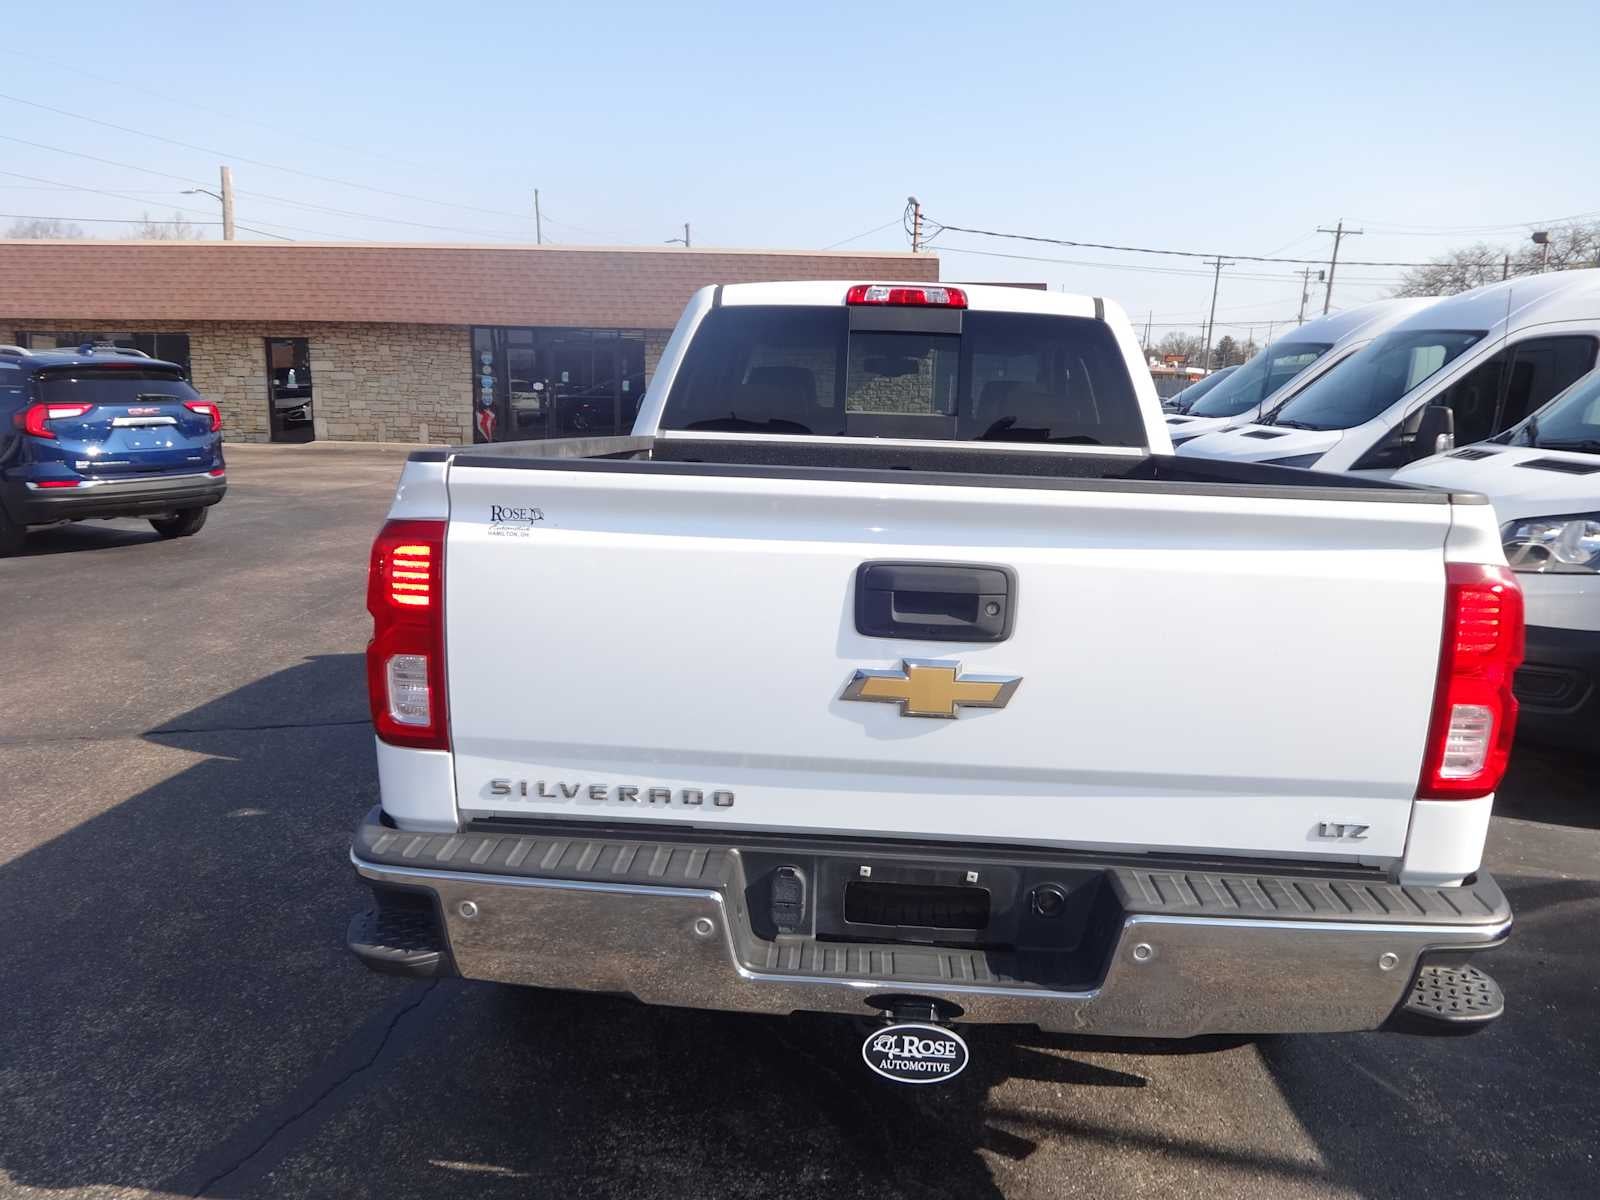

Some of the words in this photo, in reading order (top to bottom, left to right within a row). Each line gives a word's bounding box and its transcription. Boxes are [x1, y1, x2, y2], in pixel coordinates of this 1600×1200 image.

[490, 504, 529, 522] ROSE
[490, 779, 735, 807] SILVERADO
[1318, 821, 1370, 839] LTZ
[902, 1036, 956, 1058] ROSE
[879, 1059, 950, 1072] AUTOMOTIVE
